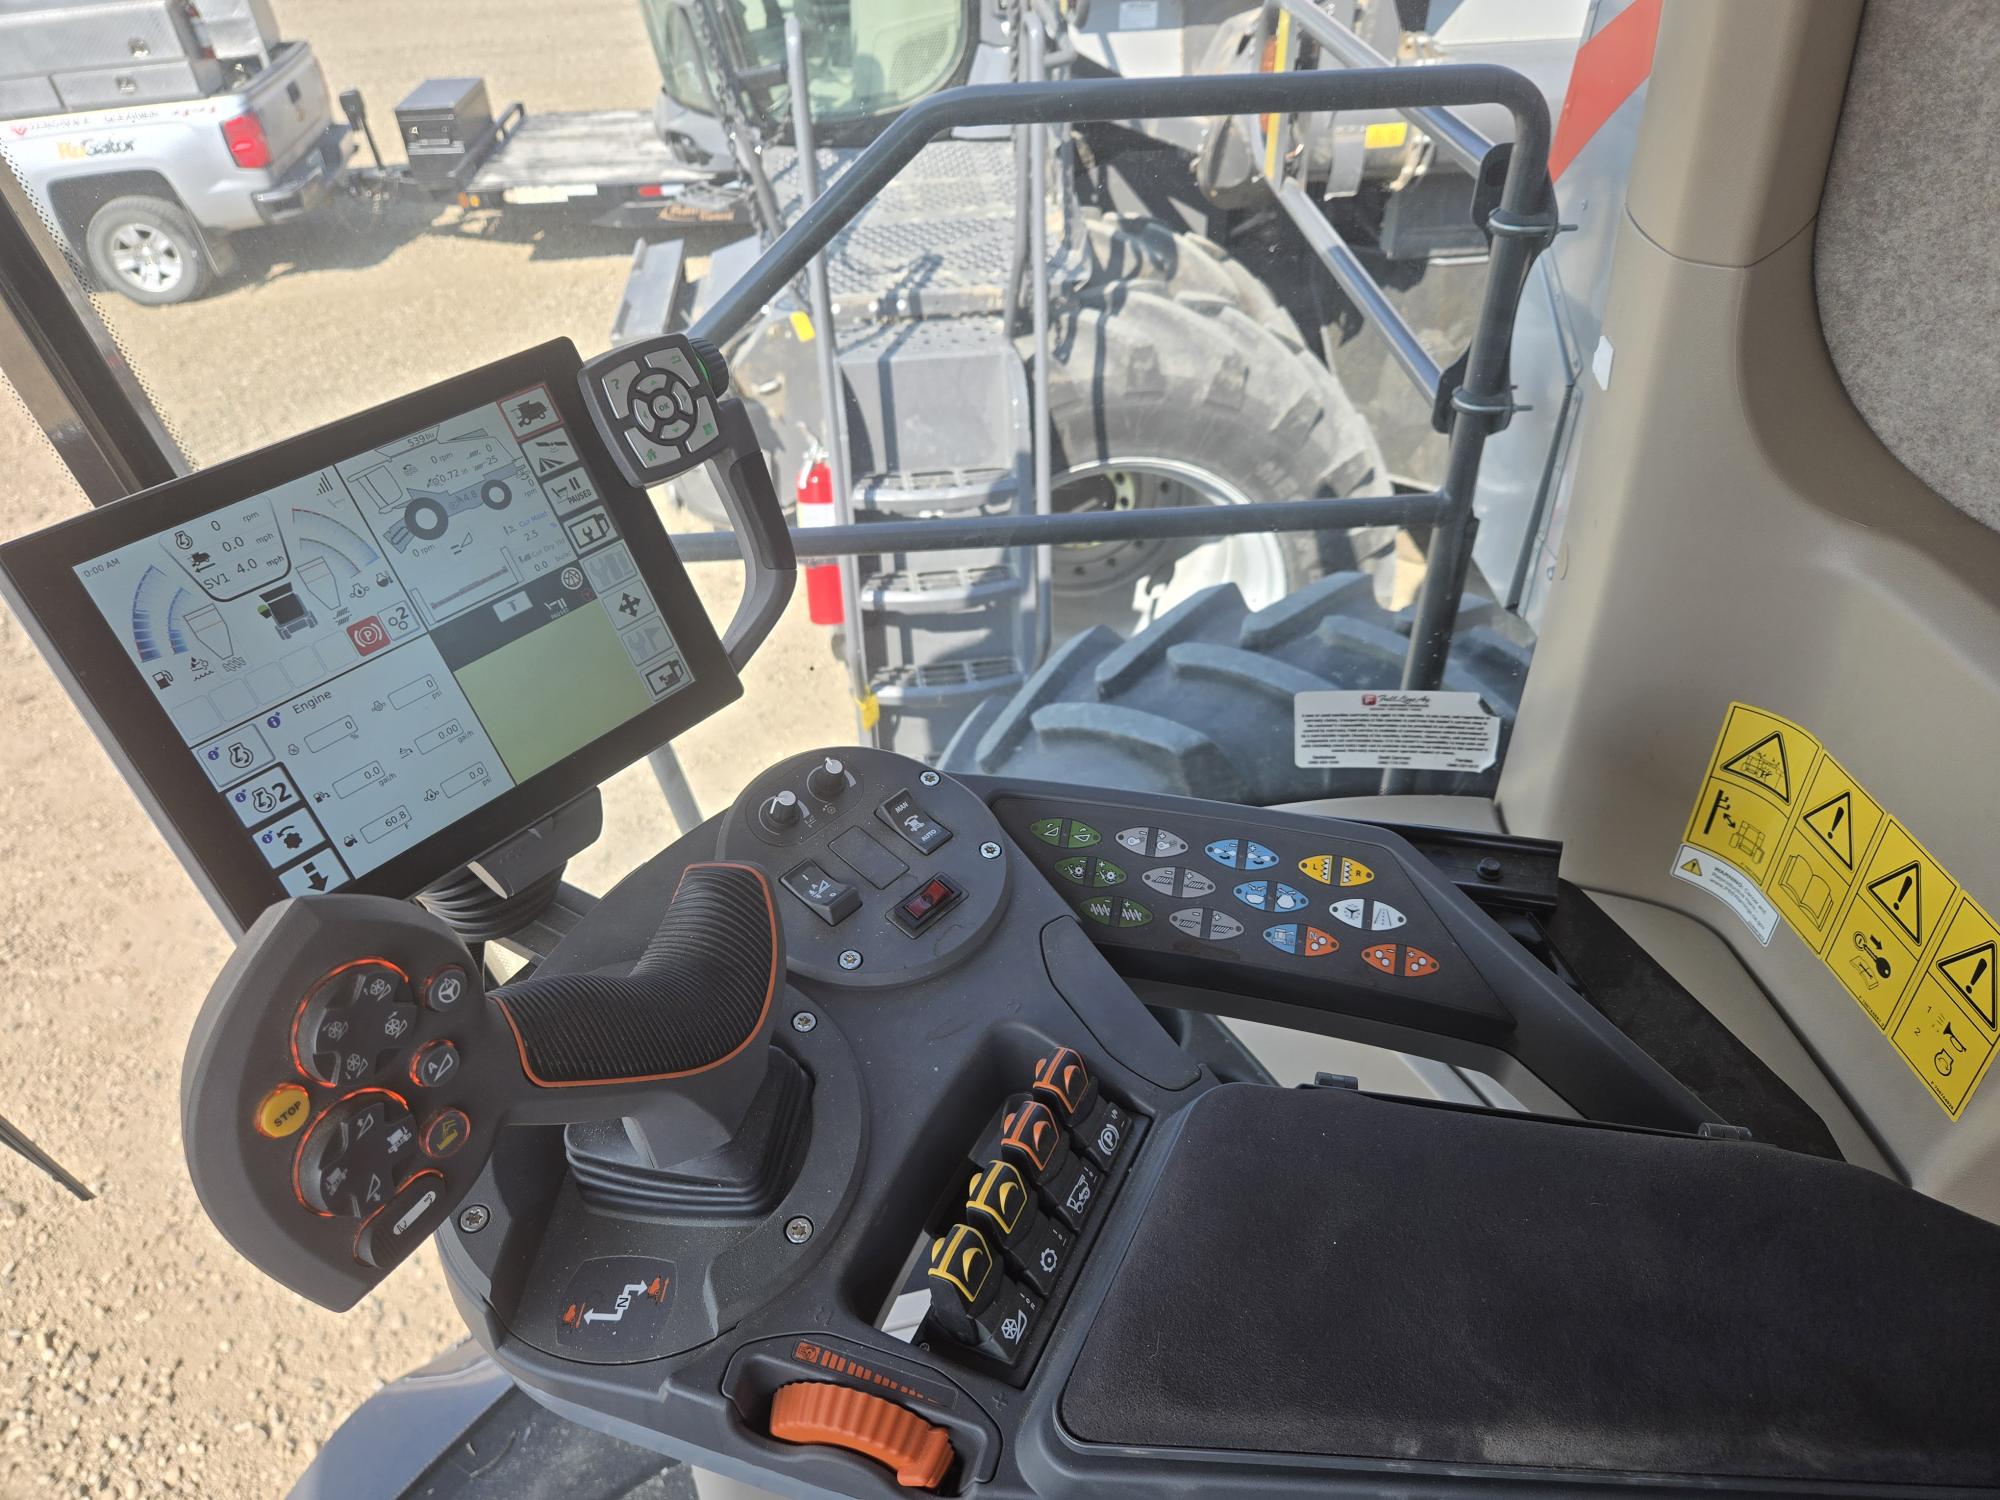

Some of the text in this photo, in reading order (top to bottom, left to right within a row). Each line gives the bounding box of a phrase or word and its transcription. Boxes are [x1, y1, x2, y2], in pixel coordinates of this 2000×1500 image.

[658, 402, 670, 411] OK
[486, 456, 498, 466] 25
[439, 469, 460, 485] 0.72
[567, 488, 593, 507] PAUSED
[210, 512, 260, 533] 0 rpm
[222, 532, 274, 553] 0.0 mph
[83, 557, 121, 578] 0:00 AM
[203, 554, 285, 591] SV1 4.0 mph
[292, 690, 332, 714] Engine
[438, 723, 459, 740] 0.00
[364, 766, 380, 781] 0.0
[468, 767, 485, 780] 0.0
[271, 781, 292, 803] 2
[895, 801, 909, 813] MAN
[384, 810, 408, 828] 60.8
[921, 829, 937, 842] AUTO
[273, 1100, 303, 1128] STOP
